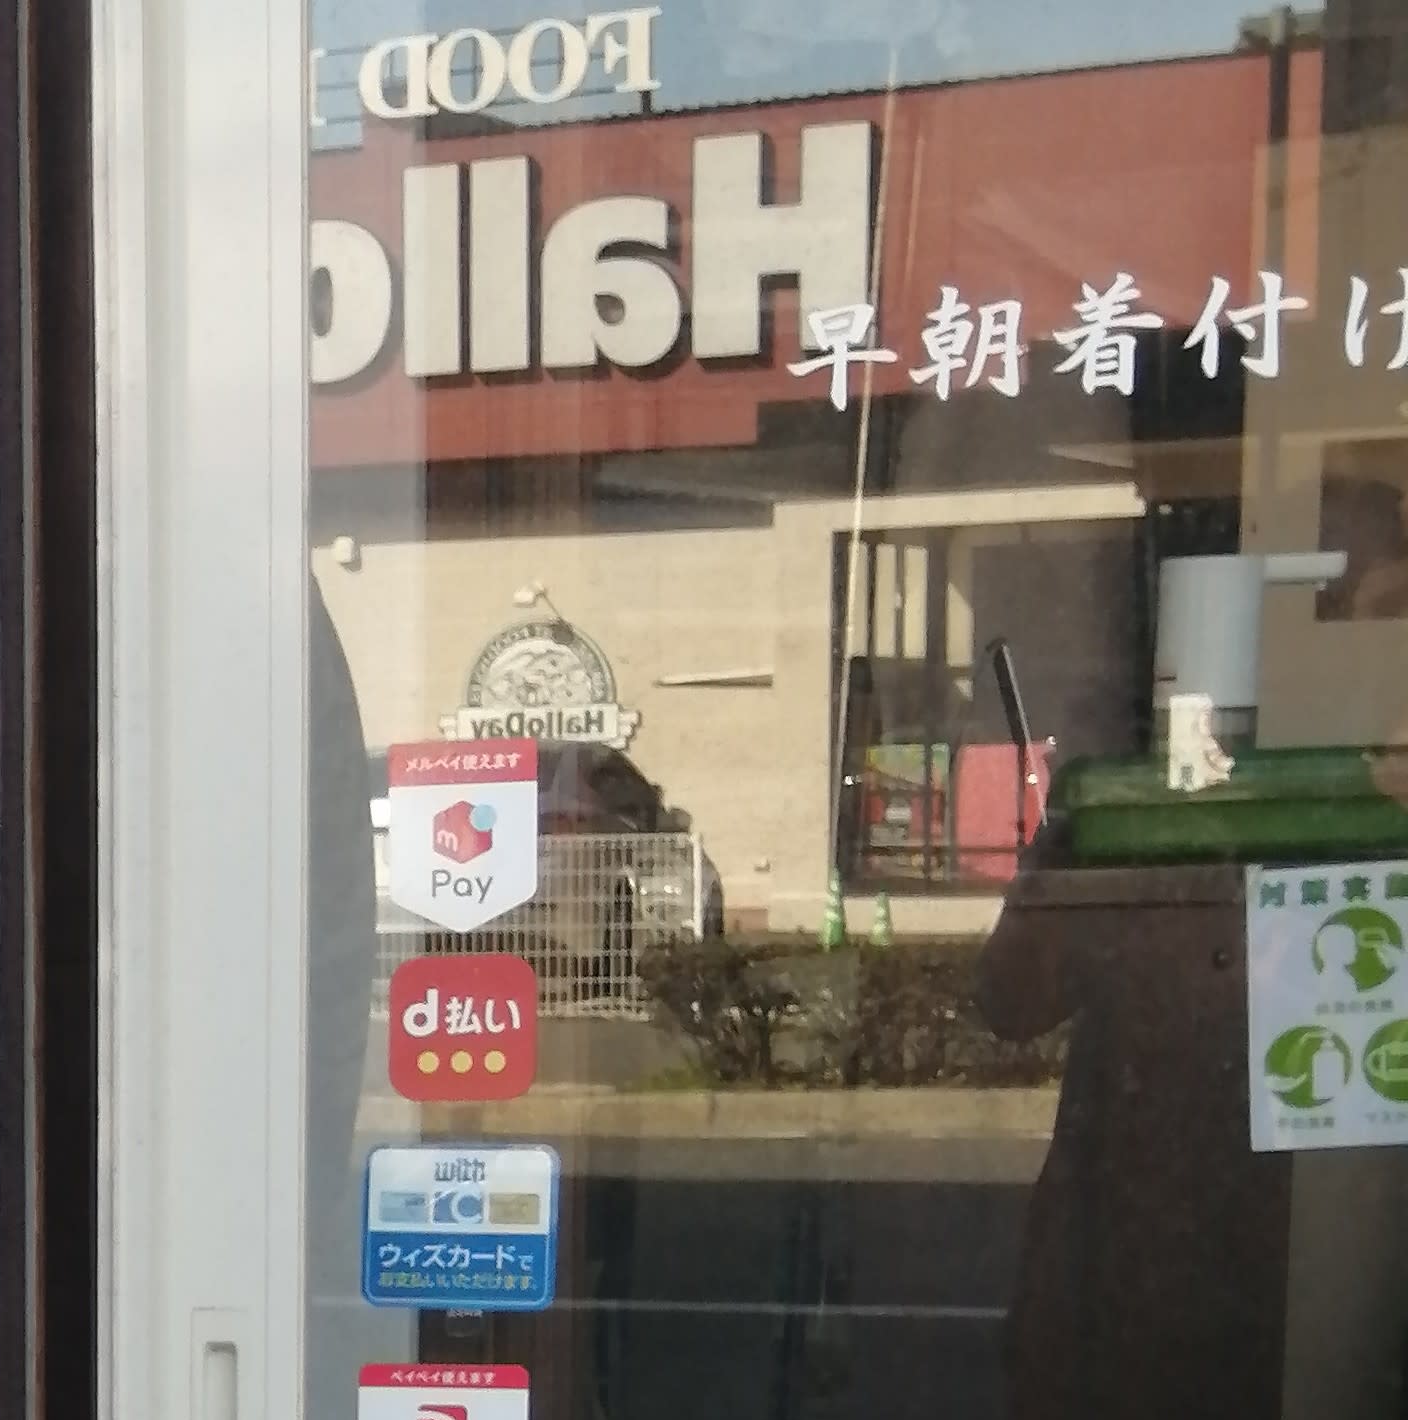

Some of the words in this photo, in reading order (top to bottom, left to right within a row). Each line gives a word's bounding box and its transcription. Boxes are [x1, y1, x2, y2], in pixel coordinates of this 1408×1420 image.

[431, 868, 494, 904] Pay
[403, 988, 521, 1038] d払い
[379, 1243, 534, 1271] ウィズカードで
